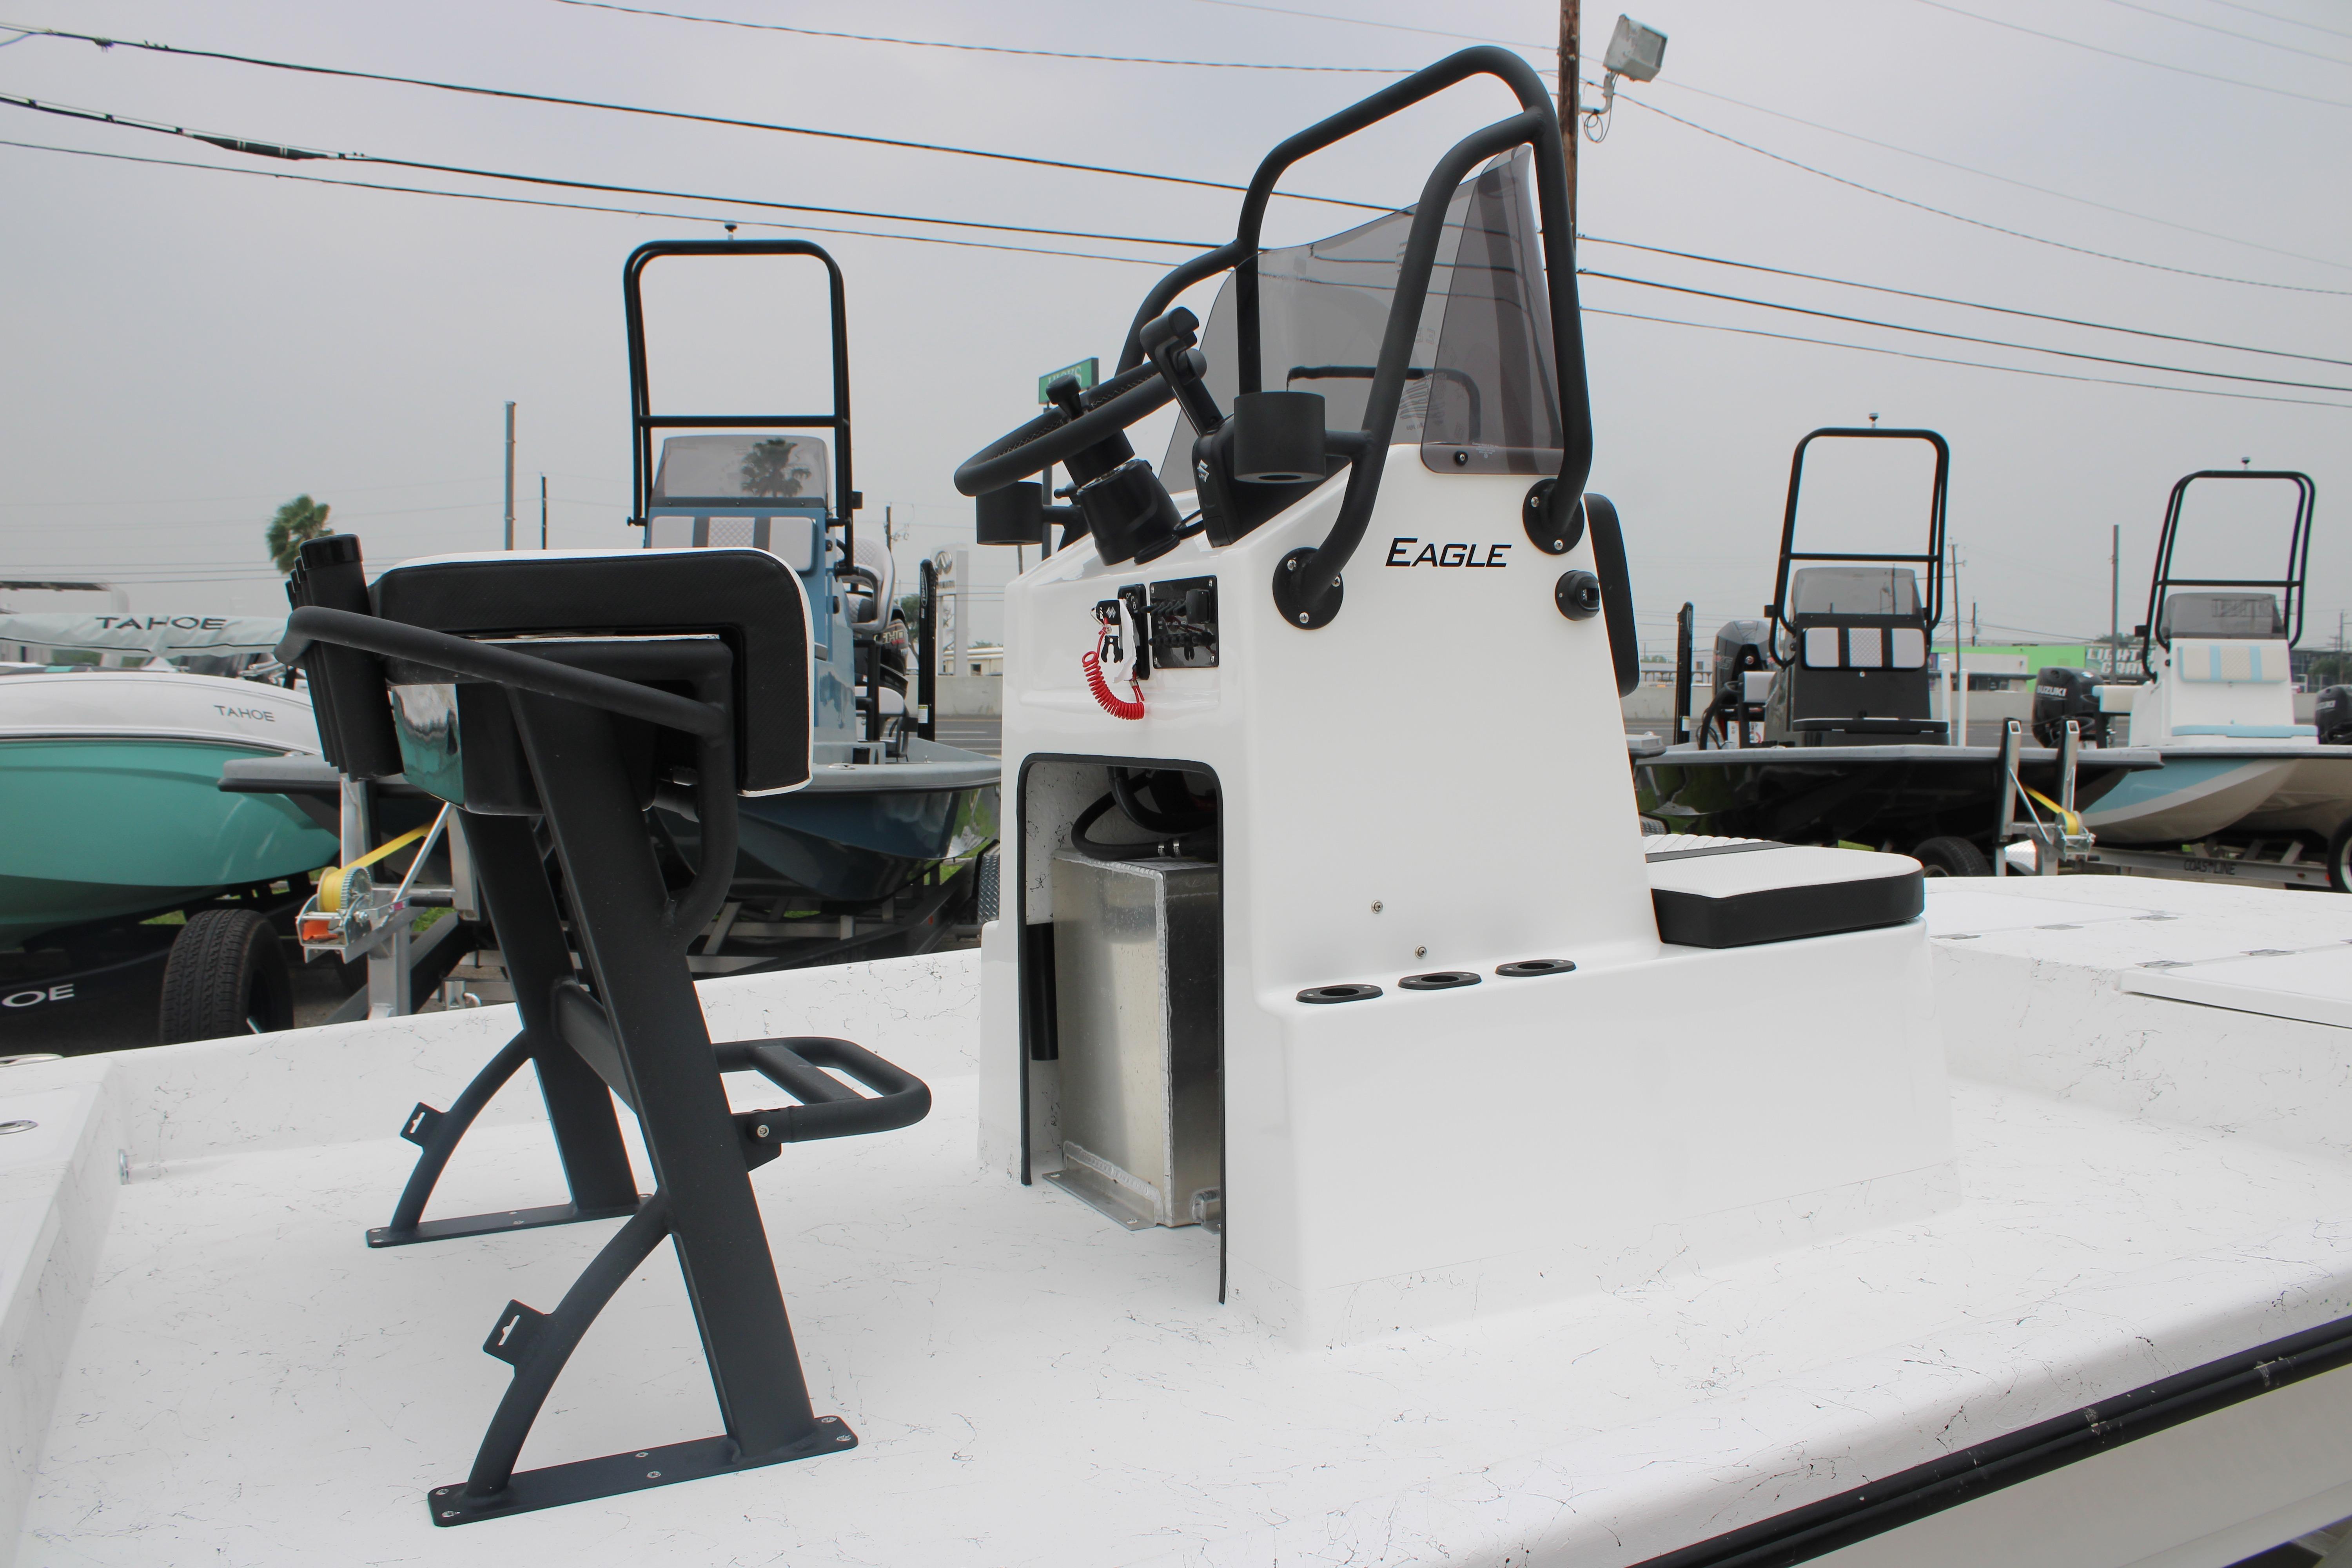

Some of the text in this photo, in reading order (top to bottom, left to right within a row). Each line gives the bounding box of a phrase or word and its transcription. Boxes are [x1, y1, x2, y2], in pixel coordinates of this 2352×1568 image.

[1385, 537, 1512, 567] EAGLE
[95, 616, 228, 631] TAHOE
[2086, 648, 2141, 661] LIGHT
[2037, 685, 2067, 697] SUZUKI
[214, 705, 276, 722] TAHOE
